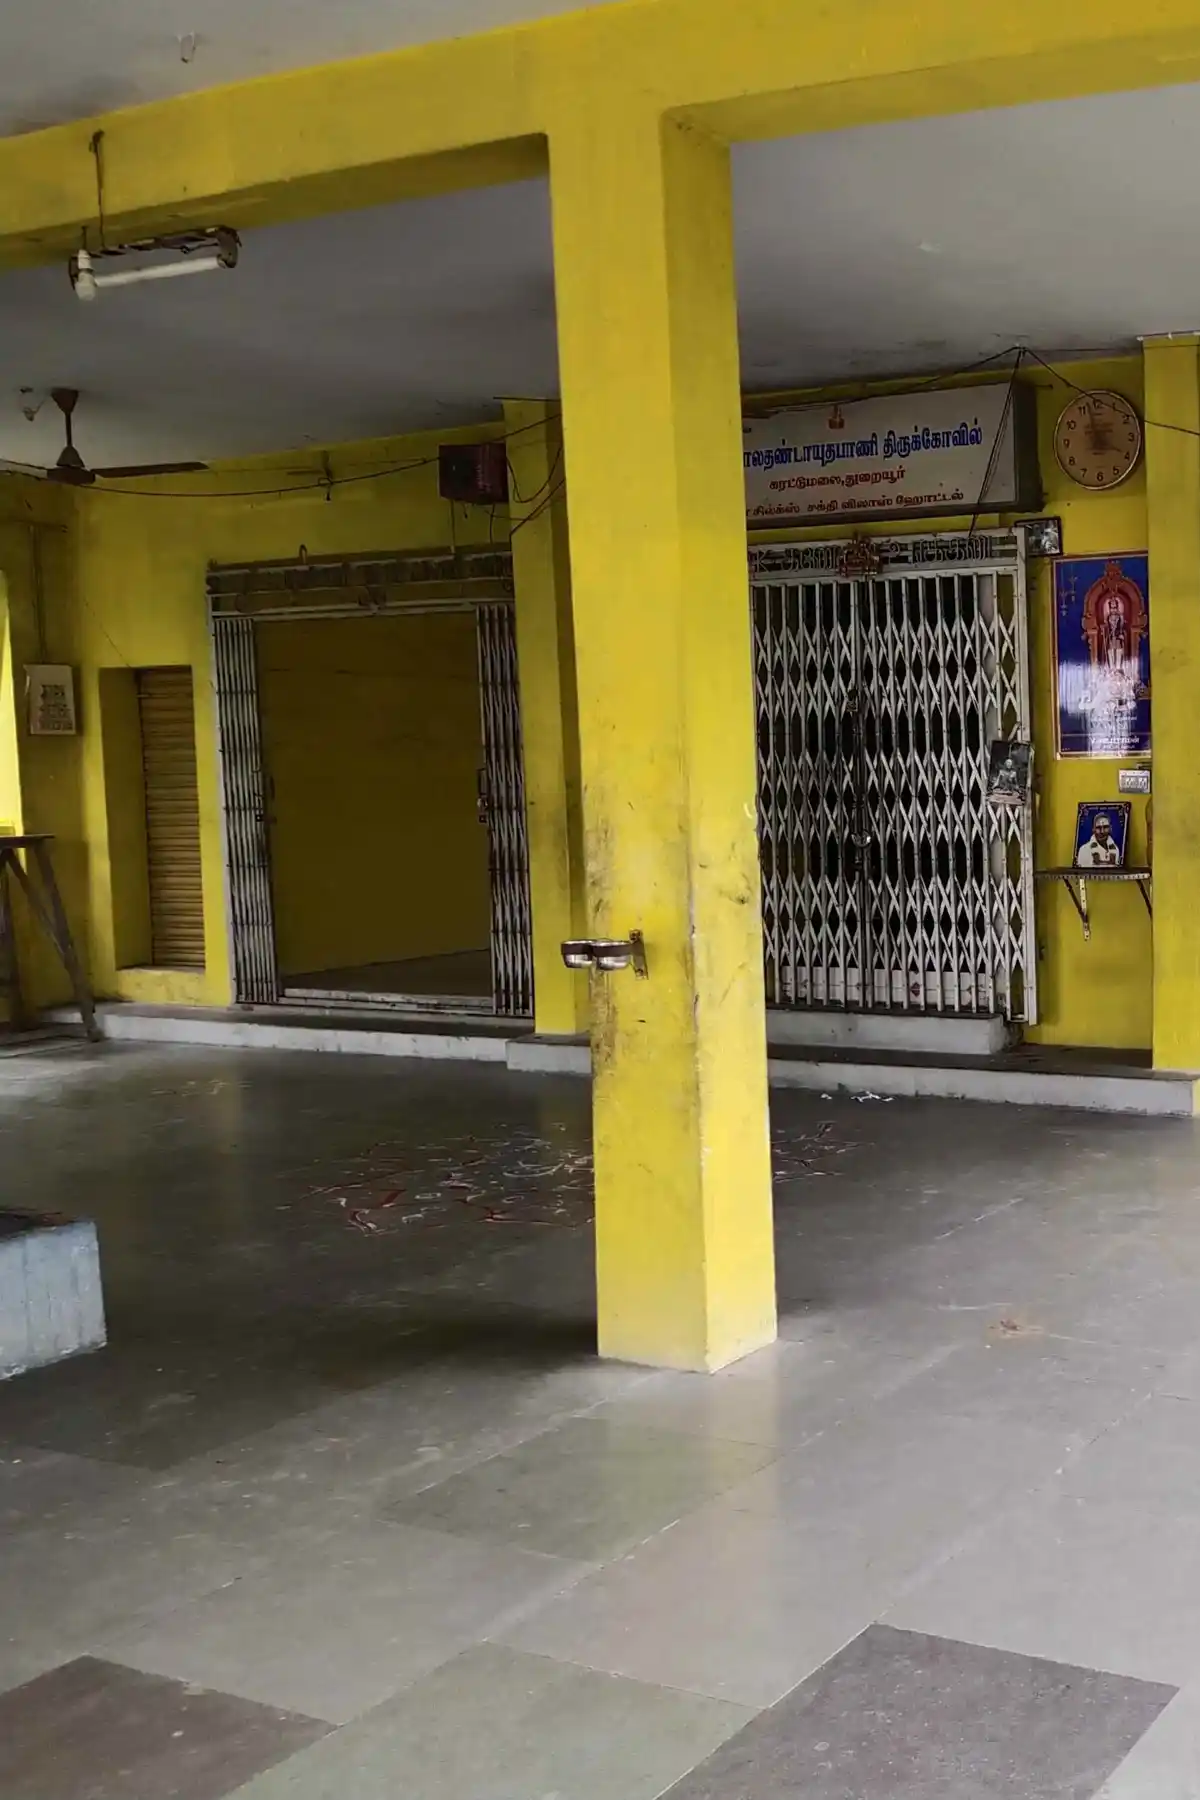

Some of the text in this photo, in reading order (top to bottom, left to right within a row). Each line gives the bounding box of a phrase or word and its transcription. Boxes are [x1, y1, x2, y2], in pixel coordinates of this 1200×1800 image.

[743, 417, 983, 471] ாலதண்டாயுதபாணி திருக்கோவில்
[841, 494, 893, 511] விலாஸ்
